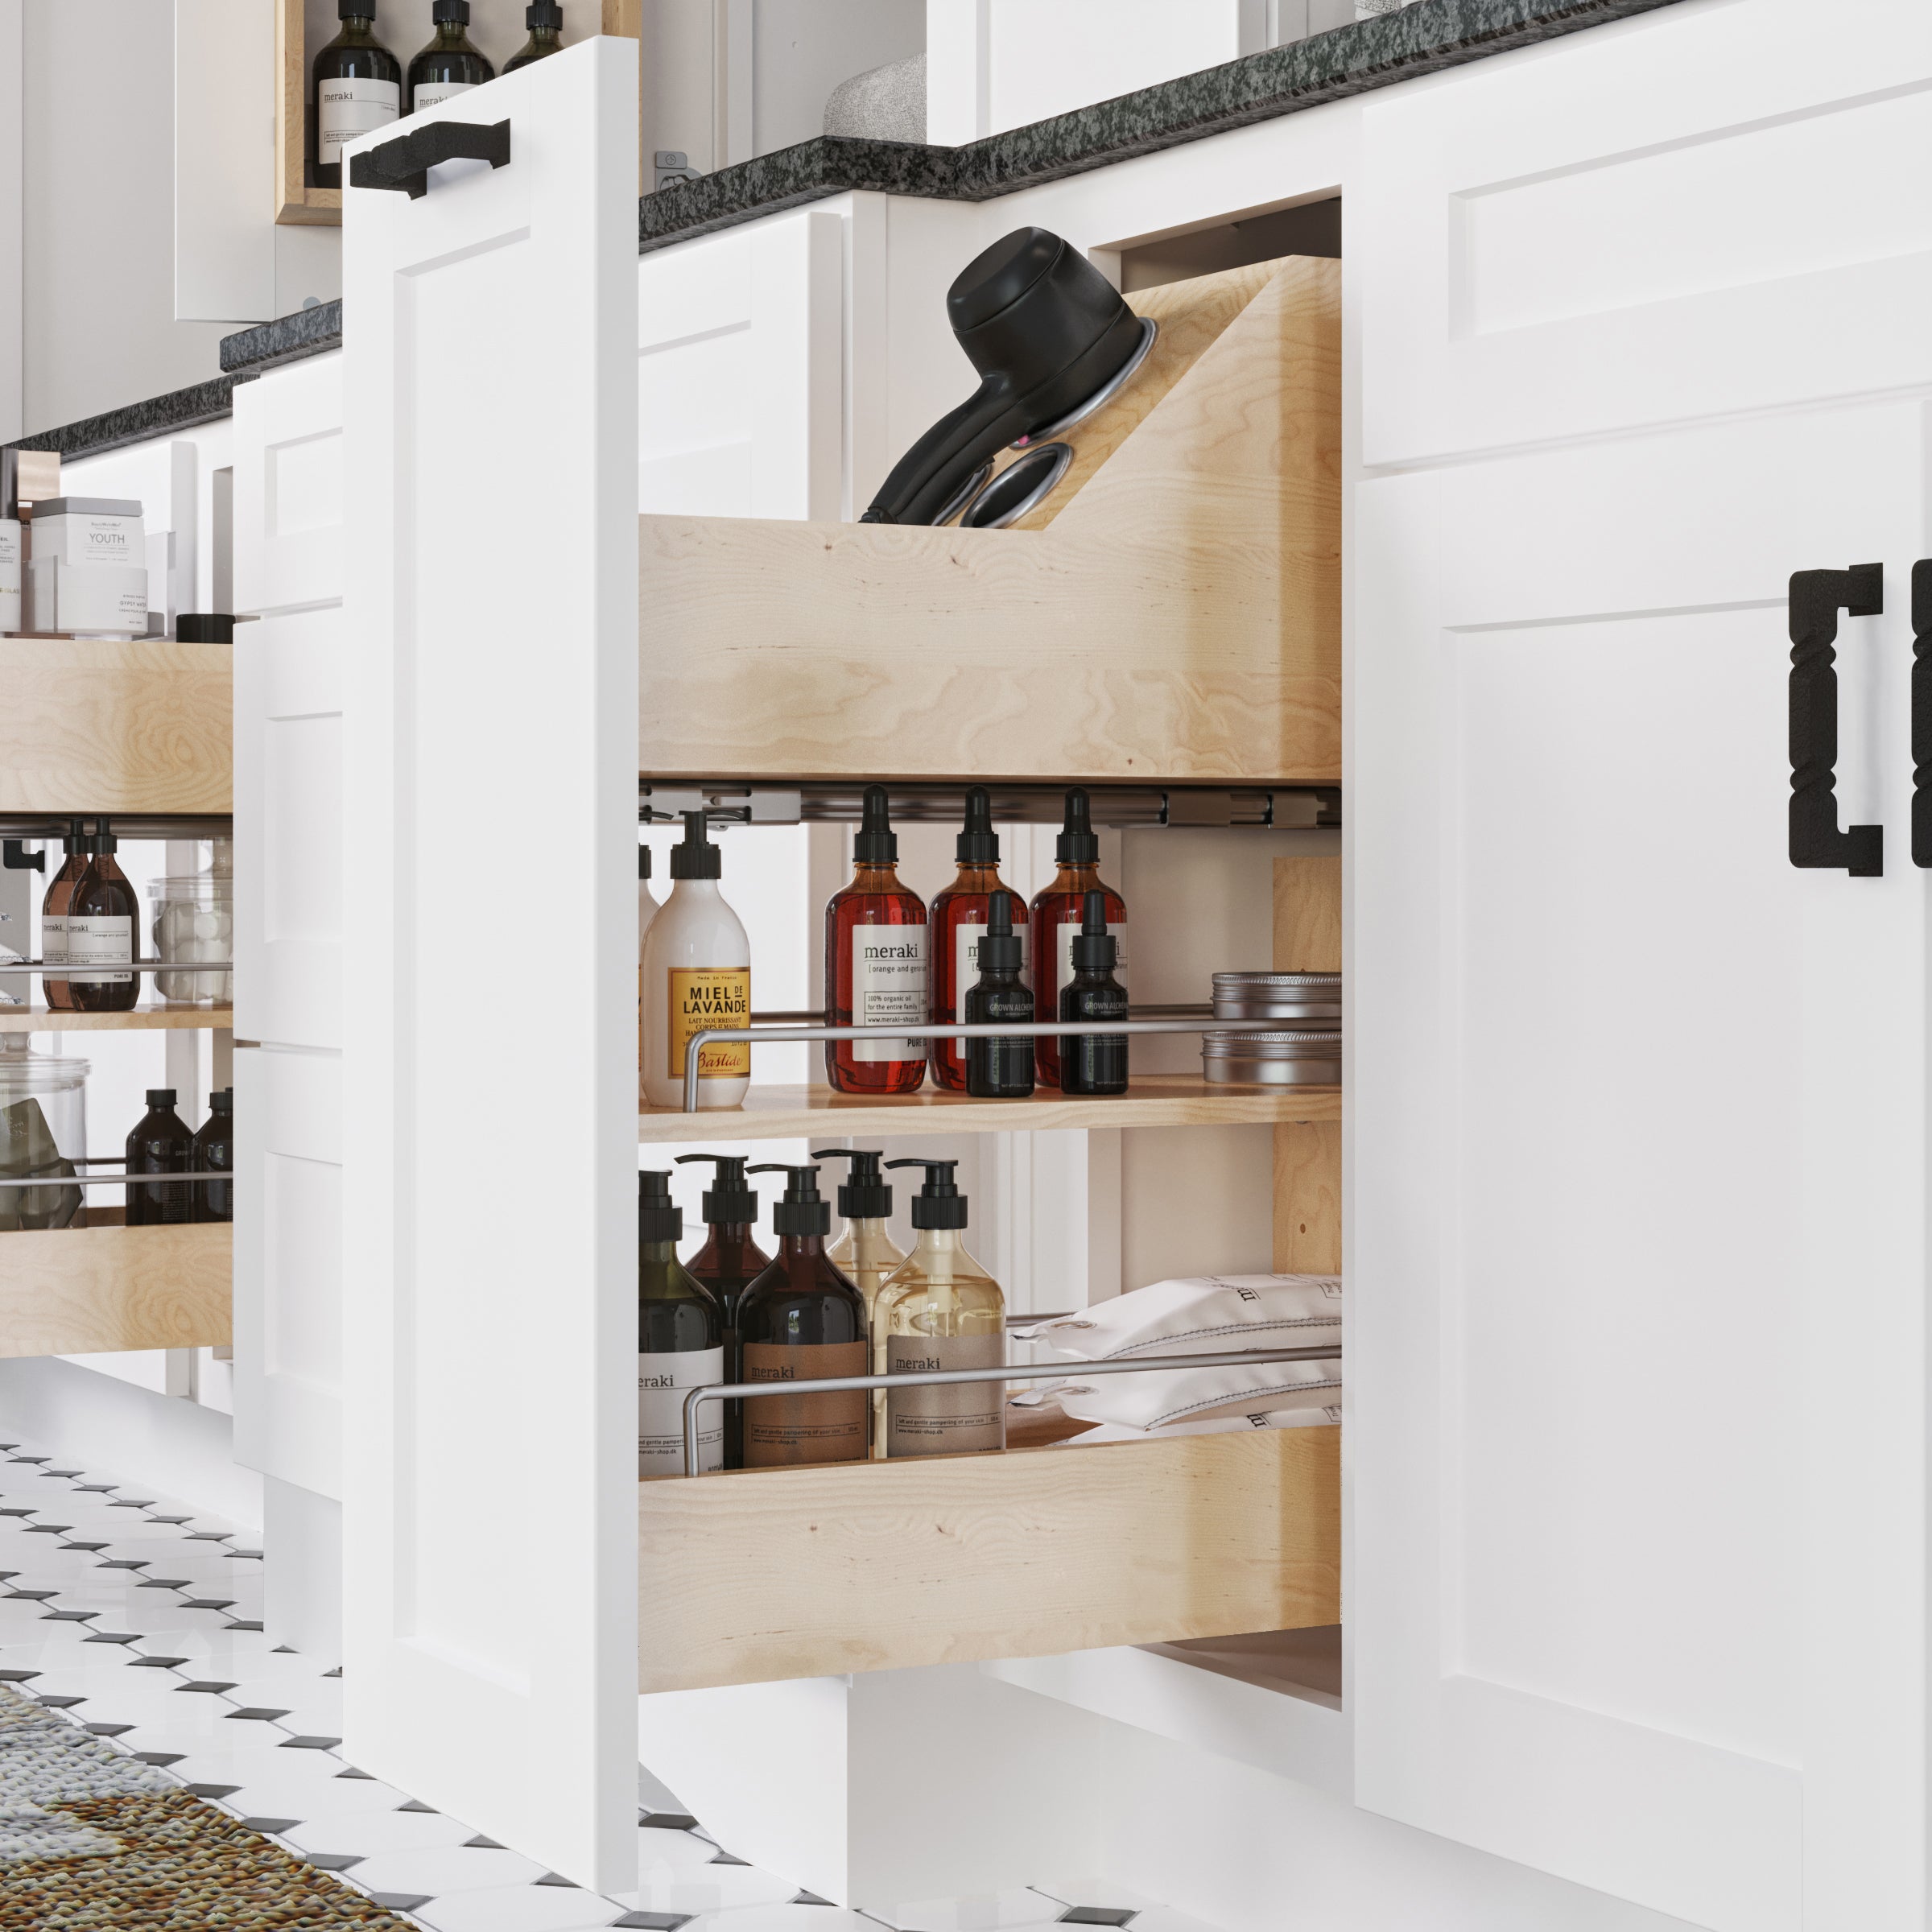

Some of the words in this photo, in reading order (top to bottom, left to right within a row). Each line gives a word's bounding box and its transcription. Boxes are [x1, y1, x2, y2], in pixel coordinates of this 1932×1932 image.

[324, 91, 353, 101] meraki
[89, 533, 125, 544] YOUTH
[865, 943, 918, 958] meraki
[690, 987, 731, 1000] MIEL
[734, 986, 742, 994] DE
[883, 995, 904, 1003] organic
[683, 1000, 746, 1013] LAVANDE
[903, 1003, 918, 1011] family
[989, 1004, 1013, 1012] GROWN
[1084, 1002, 1108, 1010] GROWN
[907, 1038, 922, 1047] PURE
[698, 1051, 742, 1068] Bastide
[896, 1357, 940, 1369] meraki
[752, 1366, 795, 1379] meraki
[638, 1374, 674, 1388] eraki
[663, 1437, 683, 1446] pamperi
